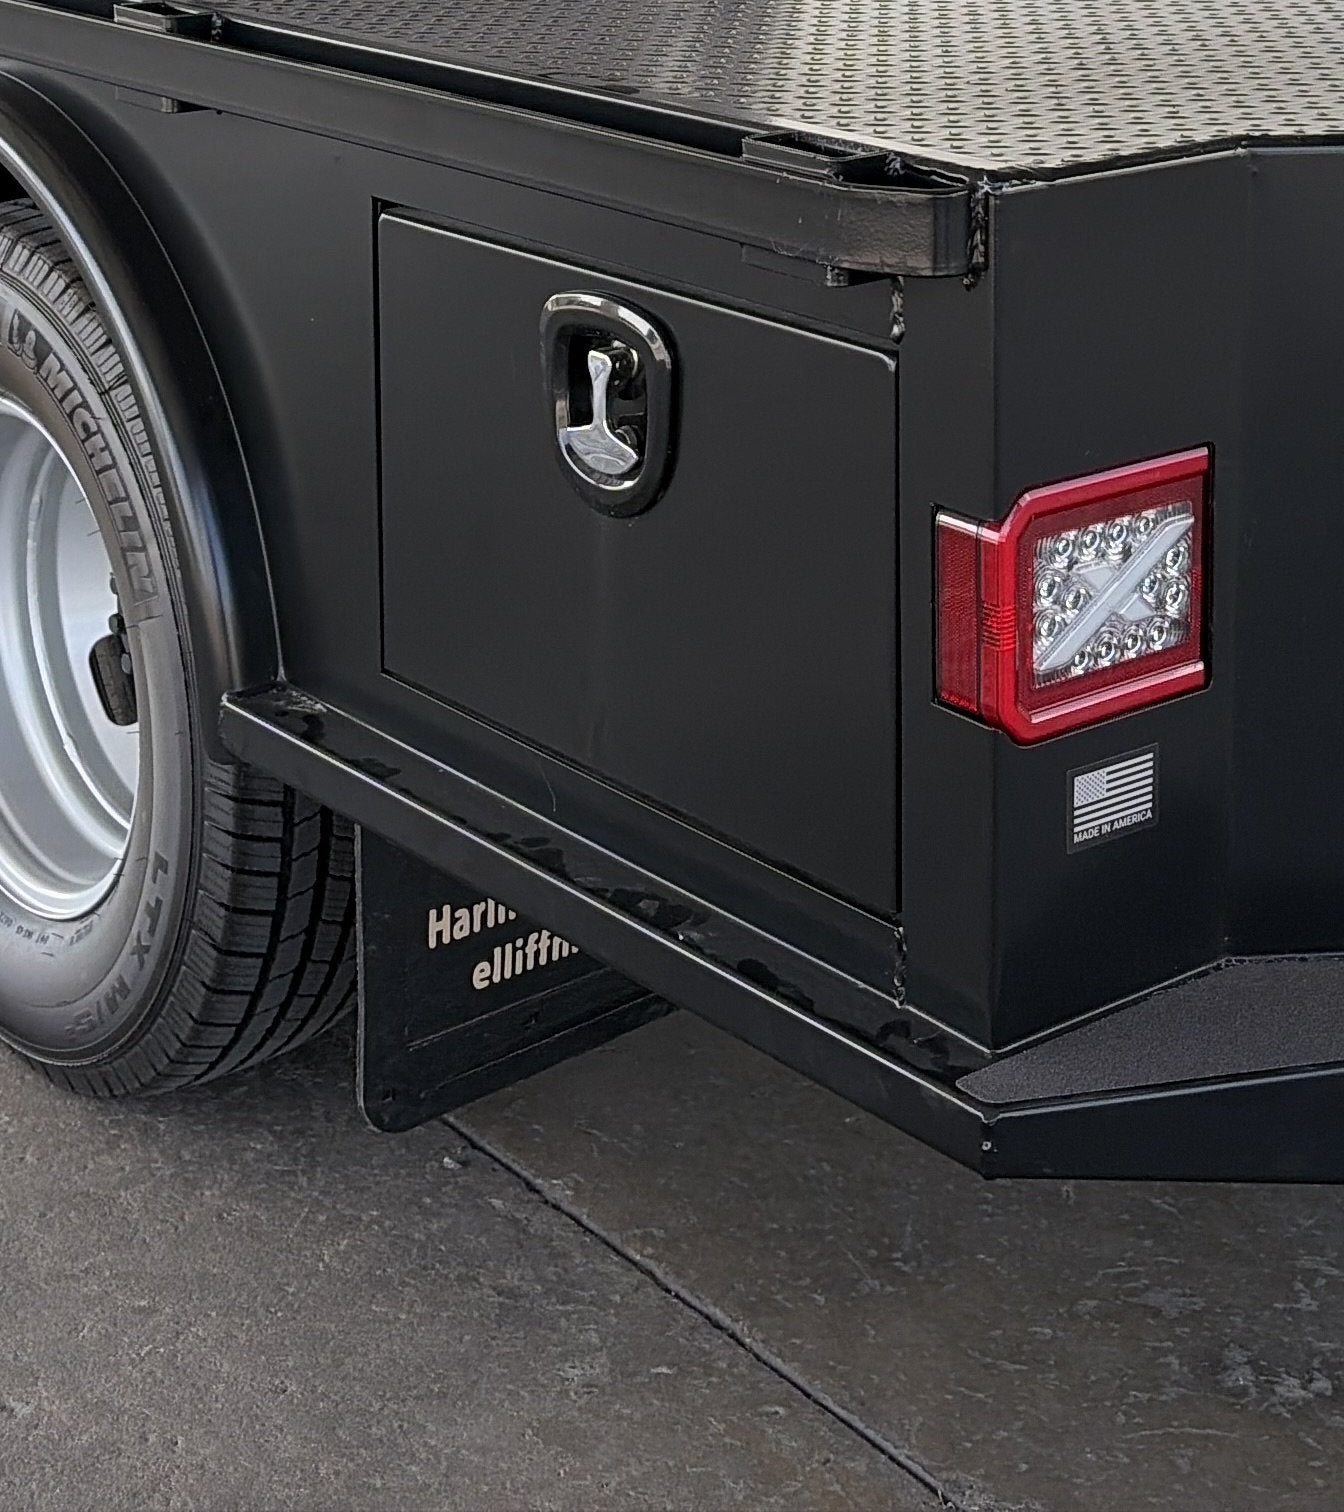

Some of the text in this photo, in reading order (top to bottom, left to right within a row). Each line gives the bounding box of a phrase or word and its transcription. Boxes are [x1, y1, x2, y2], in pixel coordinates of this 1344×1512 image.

[38, 352, 157, 598] MICHELIN
[1074, 809, 1153, 844] MADE IN AMERICA
[129, 850, 168, 972] LTX
